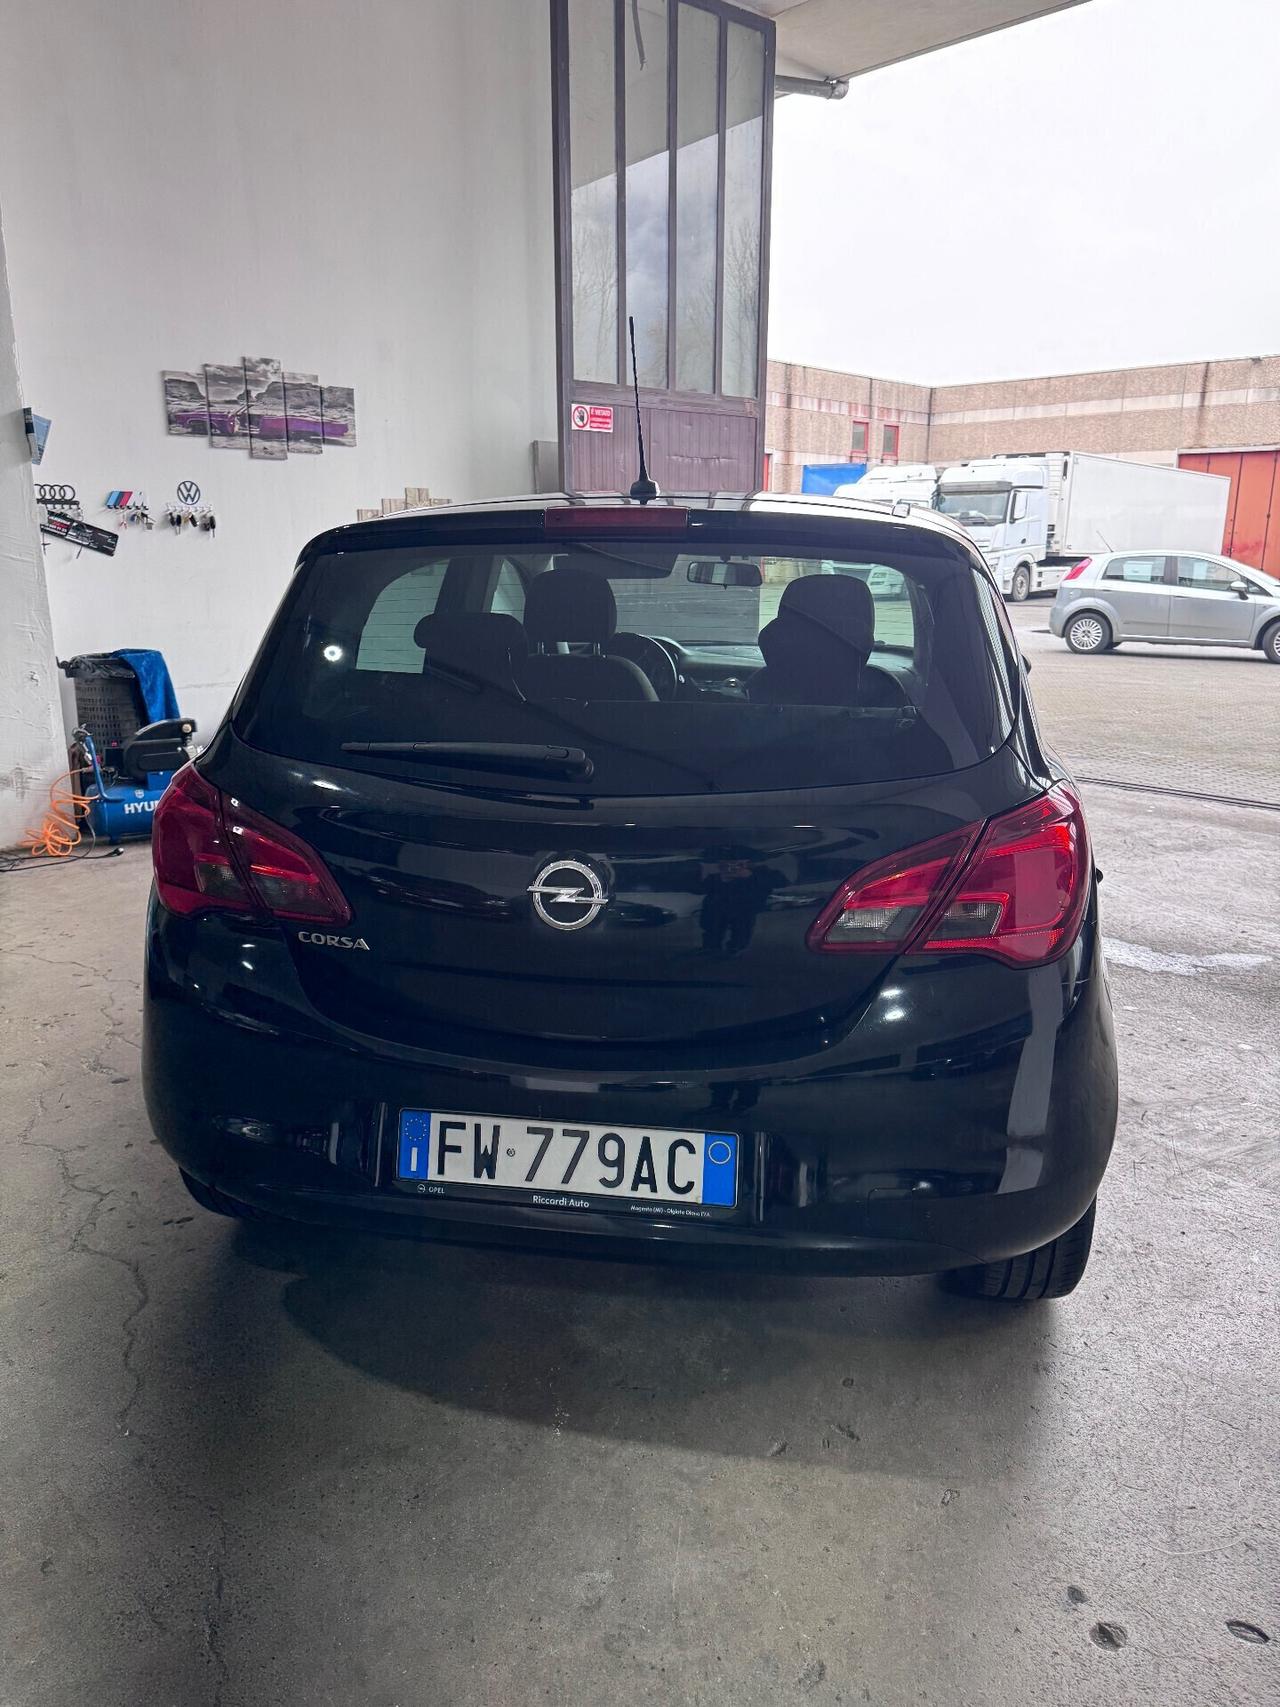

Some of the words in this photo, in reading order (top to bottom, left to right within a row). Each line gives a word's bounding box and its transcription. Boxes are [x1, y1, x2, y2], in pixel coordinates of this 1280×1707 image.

[298, 931, 370, 951] CORSA
[428, 1186, 445, 1194] OPEL
[568, 1198, 590, 1208] Auto
